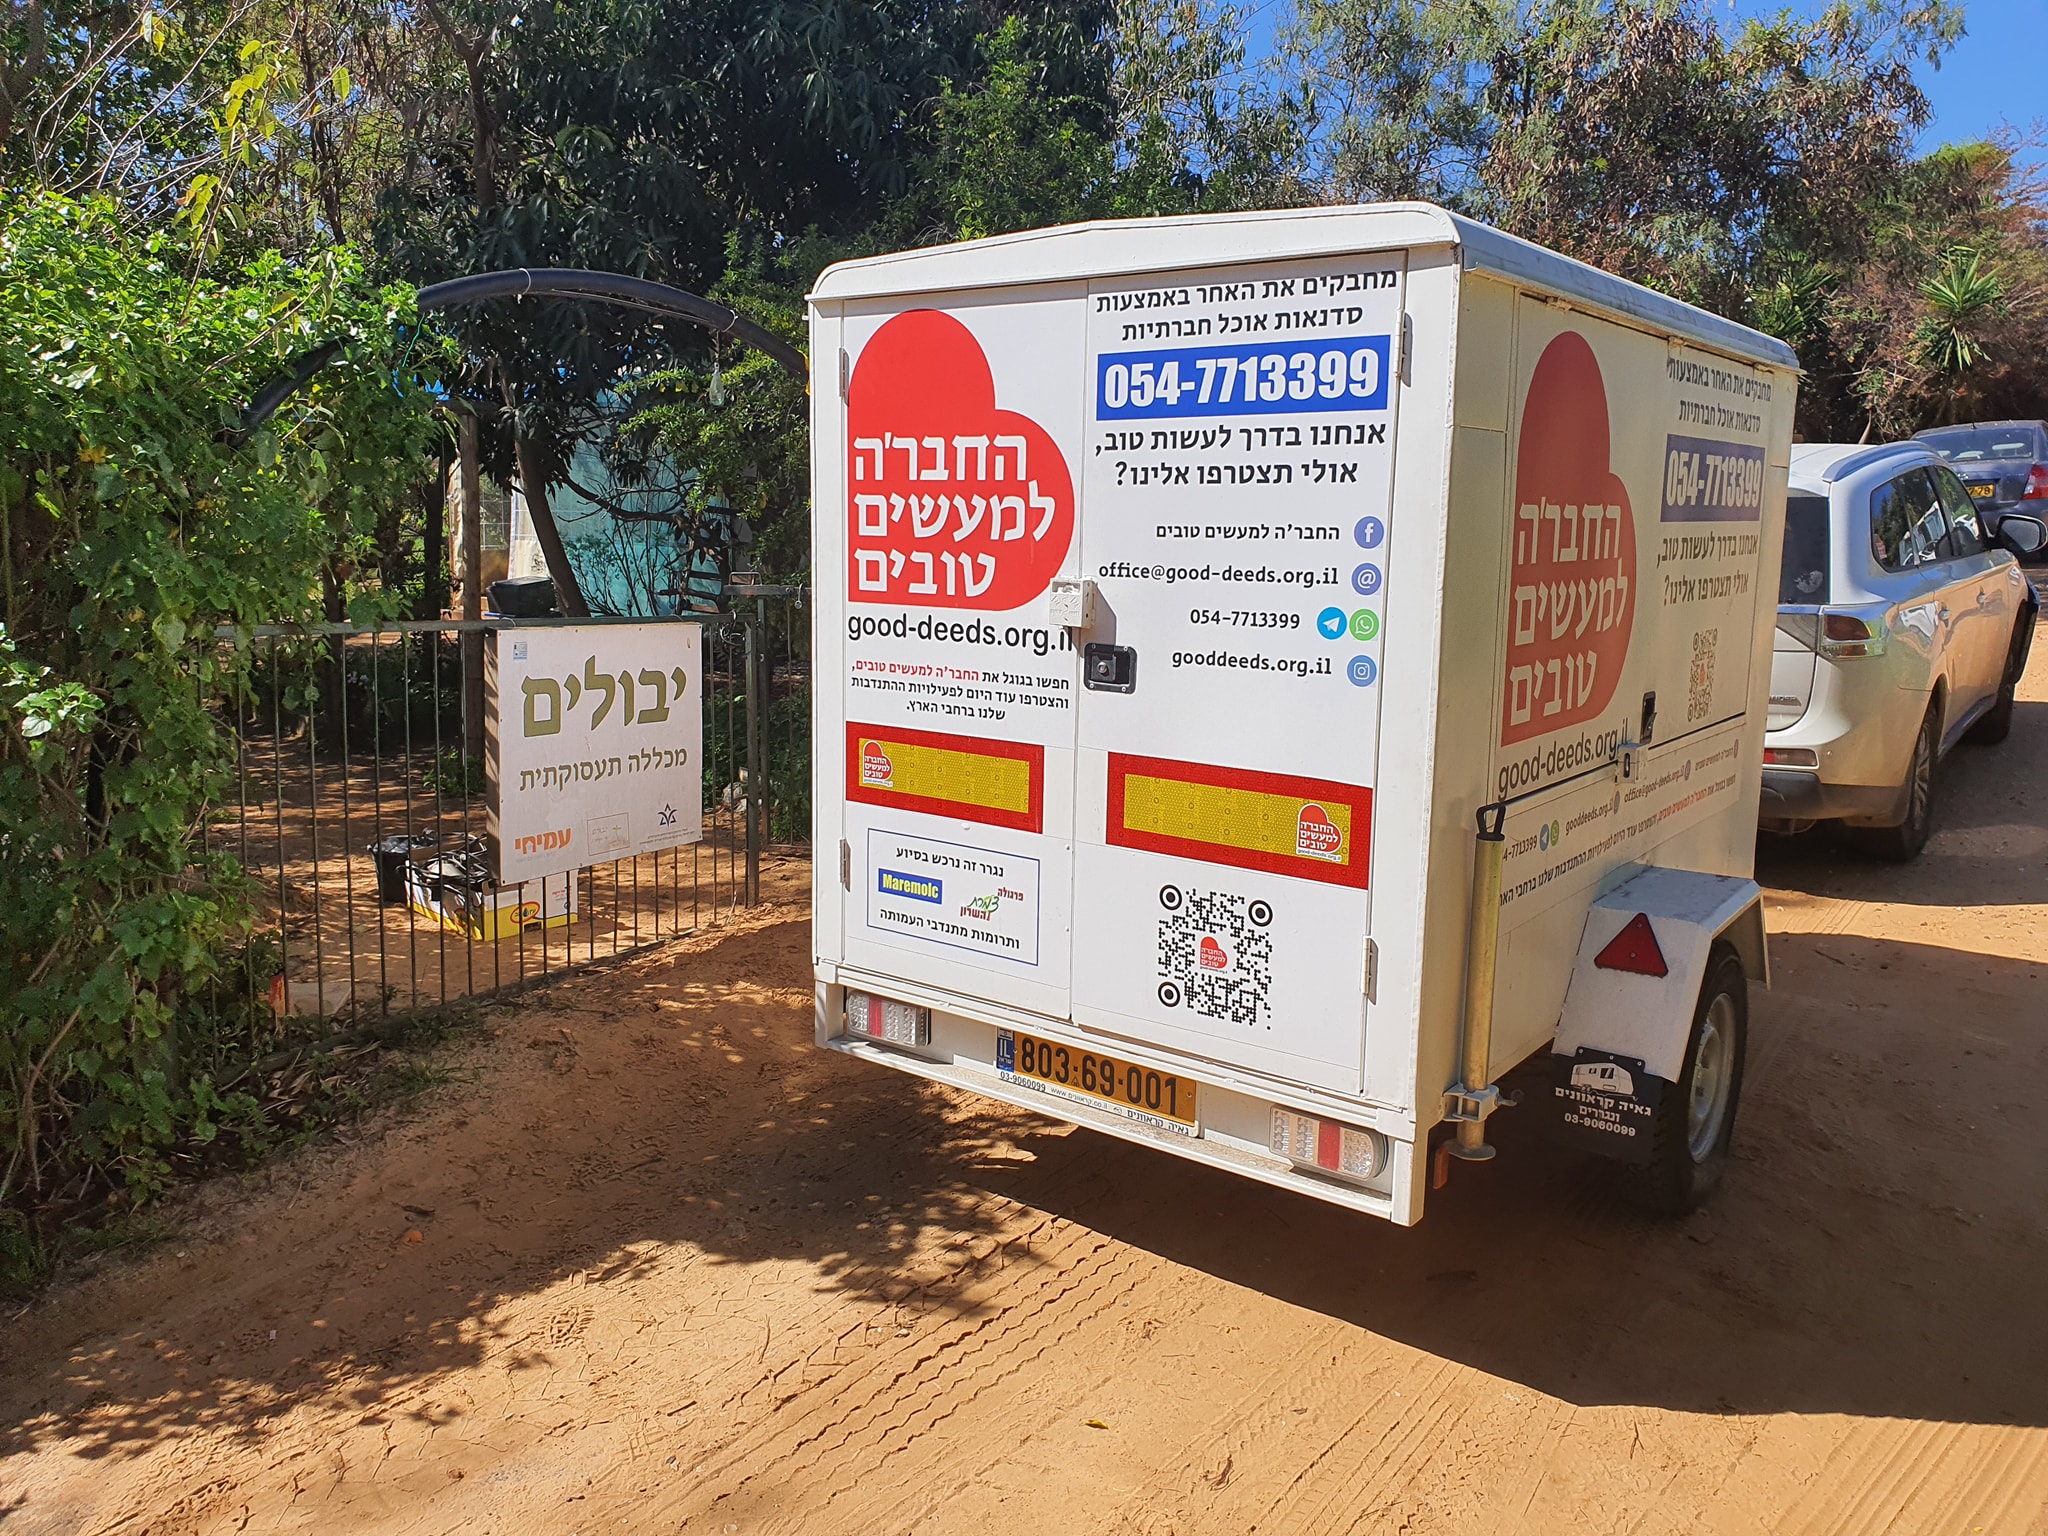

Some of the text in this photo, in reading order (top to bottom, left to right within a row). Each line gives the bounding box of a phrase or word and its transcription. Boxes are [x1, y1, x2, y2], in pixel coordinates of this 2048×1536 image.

[1096, 269, 1397, 313] מחבקים את האחר באמצעות
[1121, 306, 1363, 341] סדנאות אוכל חברתיות
[1104, 348, 1379, 409] 054-7713399
[1711, 369, 1731, 393] האחר
[1679, 400, 1761, 433] סדנאות אוכל חברתיות
[1095, 423, 1387, 457] אנחנו בדרך לעשות טוב,
[853, 432, 1027, 480] החבר'ה
[1115, 459, 1358, 487] אולי תצטרפו אלינו?
[1666, 449, 1762, 508] 054-7713399
[853, 480, 1056, 542] למעשים
[1156, 523, 1340, 540] החבר'ה למעשים טובים
[1517, 496, 1622, 565] החבר'ה
[1657, 537, 1679, 569] טוב,
[1680, 531, 1715, 560] לעשות
[1717, 535, 1737, 562] בדרך
[853, 548, 996, 597] טובים
[1099, 562, 1339, 588] office@good-deeds.org.il
[1514, 556, 1628, 646] למעשים
[1664, 574, 1696, 606] אלינו?
[1698, 575, 1732, 600] תצטרפו
[1190, 609, 1300, 629] 054-7713399
[851, 660, 1069, 690] חפשו בגוגל את החבר'ה למעשים טובים,
[1172, 650, 1332, 677] gooddeeds.org.il
[520, 654, 688, 738] יבולים
[851, 676, 1069, 709] והצטרפו עוד היום לפעילויות ההתנדבות
[1509, 650, 1597, 726] טובים
[906, 700, 1006, 720] שלנו ברחבי הארץ.
[519, 746, 688, 792] מכללה תעסוקתית
[1498, 717, 1628, 801] good-deeds.orgil
[514, 828, 572, 855] עמיחי
[1299, 838, 1327, 850] טובים
[1300, 830, 1339, 843] למעשים
[896, 847, 1005, 878] נגרר זה נרכש בסיוע
[882, 873, 939, 899] Maremolc
[997, 887, 1024, 901] פרגולה
[880, 908, 1020, 949] ותרומות מתנדבי העמותה
[1000, 1039, 1011, 1058] IL
[1000, 1070, 1046, 1093] 03-9060099
[1555, 1087, 1652, 1116] גאיה קראוונים
[1579, 1105, 1620, 1122] ונגררים
[1127, 1110, 1164, 1129] קראוונים
[1168, 1121, 1190, 1136] גאיה
[1564, 1112, 1636, 1137] 03-9060099
